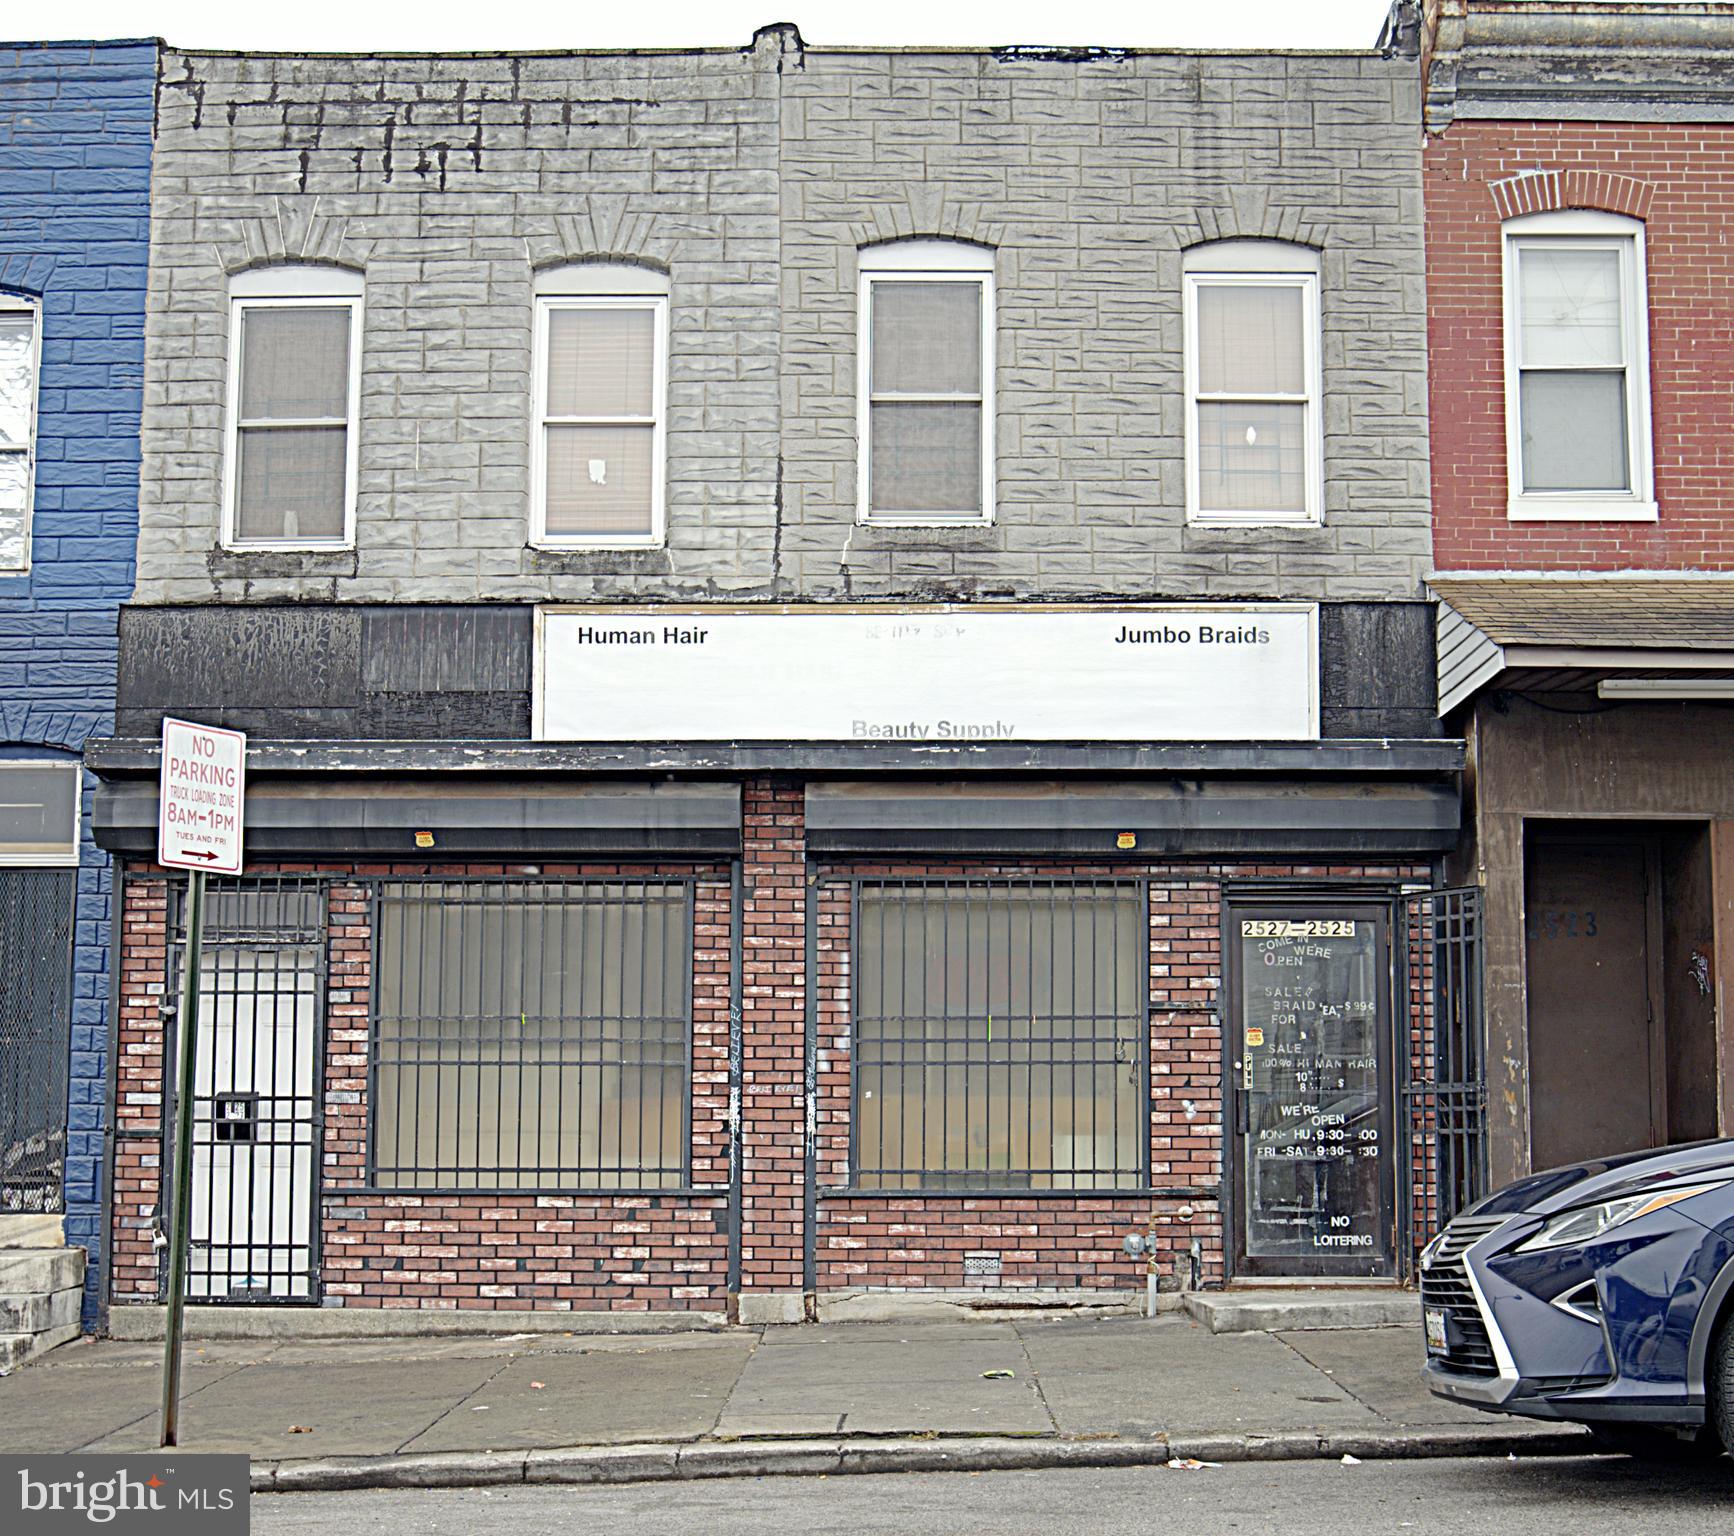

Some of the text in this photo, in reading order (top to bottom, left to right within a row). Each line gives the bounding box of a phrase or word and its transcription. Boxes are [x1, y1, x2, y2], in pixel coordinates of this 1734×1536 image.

[577, 627, 709, 644] Human Hair
[1115, 626, 1270, 644] Jumbo Braids
[852, 720, 1015, 739] Beauty Supply
[192, 735, 215, 758] NO
[170, 757, 235, 788] PARKING
[170, 784, 235, 809] TRUCK LOADING ZONE
[167, 802, 234, 832] 8AM-1PM
[175, 831, 227, 846] TUES AND FRI
[1257, 935, 1293, 953] COME
[1264, 952, 1303, 966] OPEN
[1271, 1014, 1296, 1025] FOR
[1281, 1102, 1320, 1117] WE'RE
[1311, 1114, 1345, 1126] OPEN
[1330, 1216, 1350, 1227] NO
[1313, 1235, 1373, 1246] LOITERING
